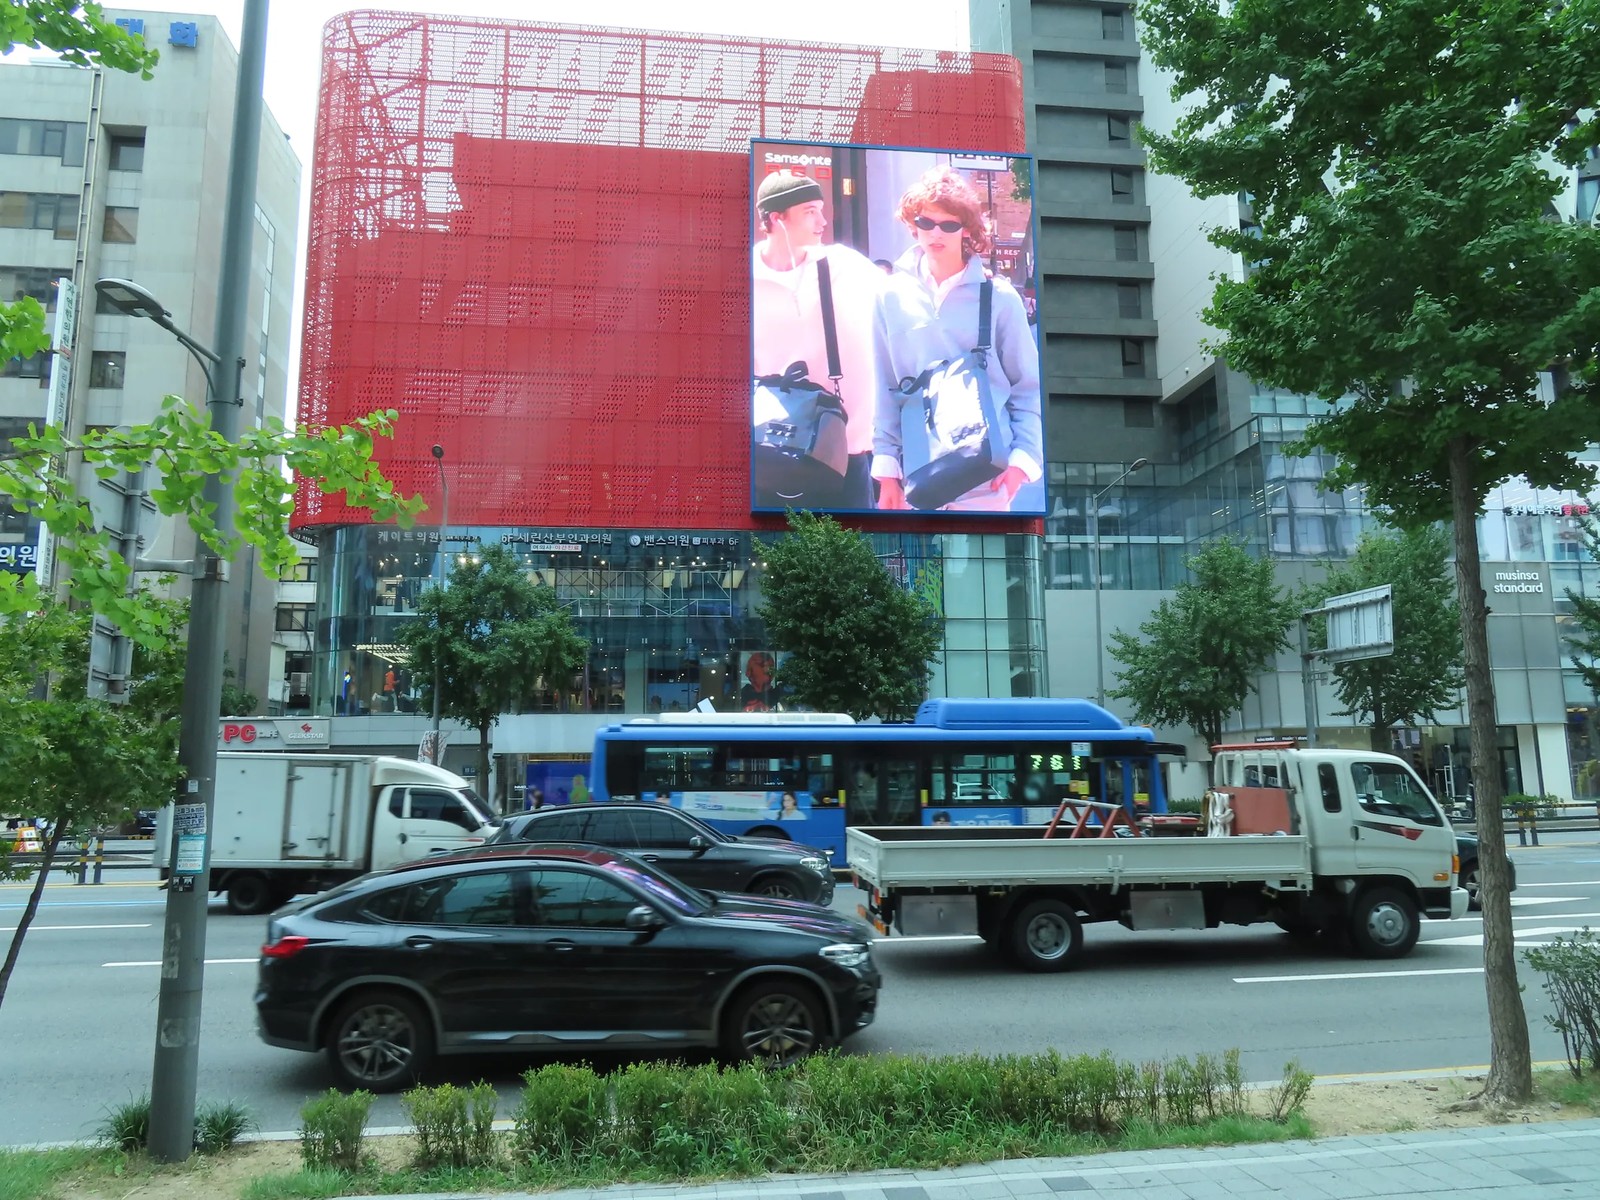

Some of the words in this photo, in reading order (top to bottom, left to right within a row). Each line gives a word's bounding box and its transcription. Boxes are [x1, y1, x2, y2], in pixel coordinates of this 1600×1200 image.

[765, 152, 832, 166] Samsonite
[377, 531, 439, 543] 케이트의원
[517, 532, 613, 545] 세린산부인과의원
[644, 534, 690, 547] 밴스의원
[728, 537, 740, 546] 6F
[1495, 569, 1539, 581] musinsa
[1494, 582, 1544, 594] standard
[223, 724, 257, 743] PC
